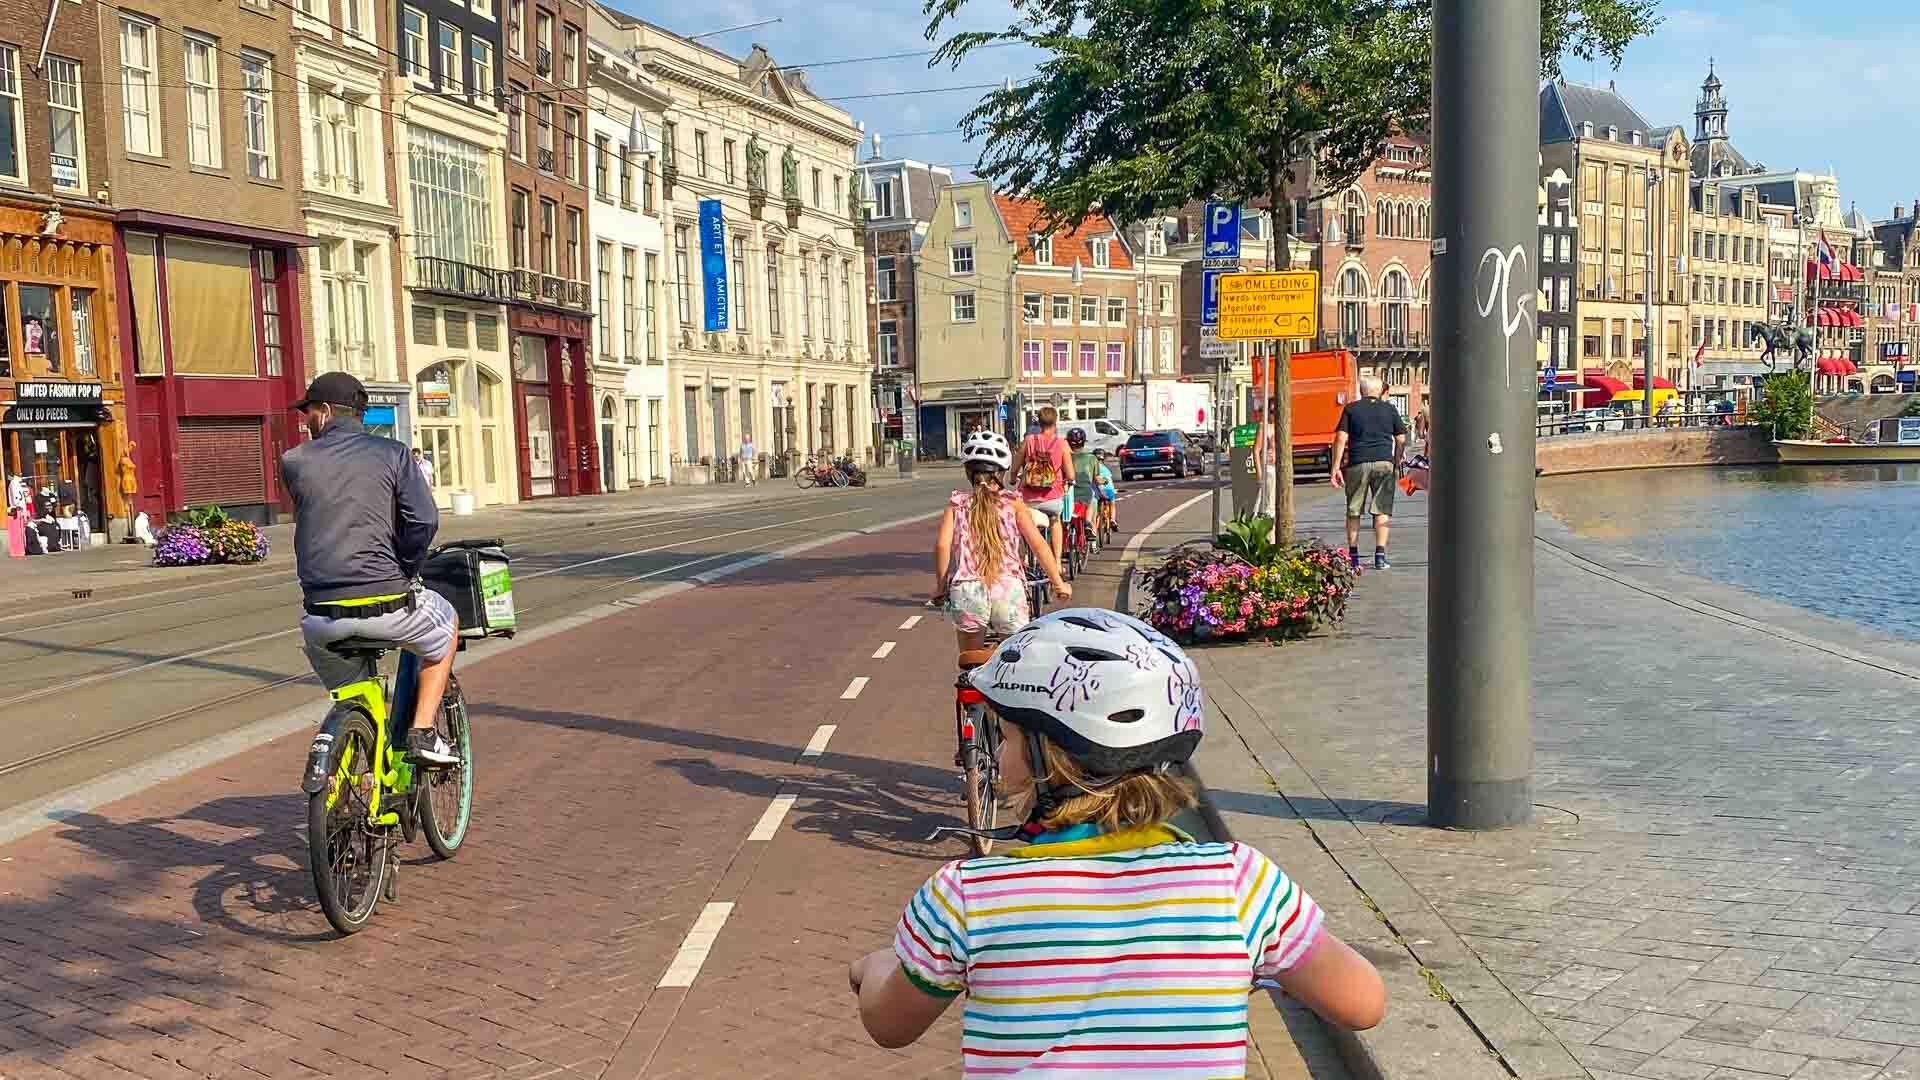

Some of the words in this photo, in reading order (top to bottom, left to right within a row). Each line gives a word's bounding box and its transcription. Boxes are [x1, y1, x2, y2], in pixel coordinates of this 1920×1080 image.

[1212, 206, 1233, 235] P
[711, 216, 722, 240] ARTI
[714, 243, 723, 256] ET
[1245, 278, 1310, 289] OMLEIDING
[716, 277, 726, 327] AMICITIAE
[20, 383, 48, 398] LIMITED
[49, 384, 77, 398] FASHION
[77, 384, 92, 398] POP
[92, 385, 102, 398] UP
[16, 407, 34, 420] ONLY
[35, 408, 45, 420] 80
[46, 407, 69, 420] PIECES
[991, 682, 1052, 696] ALPINA
